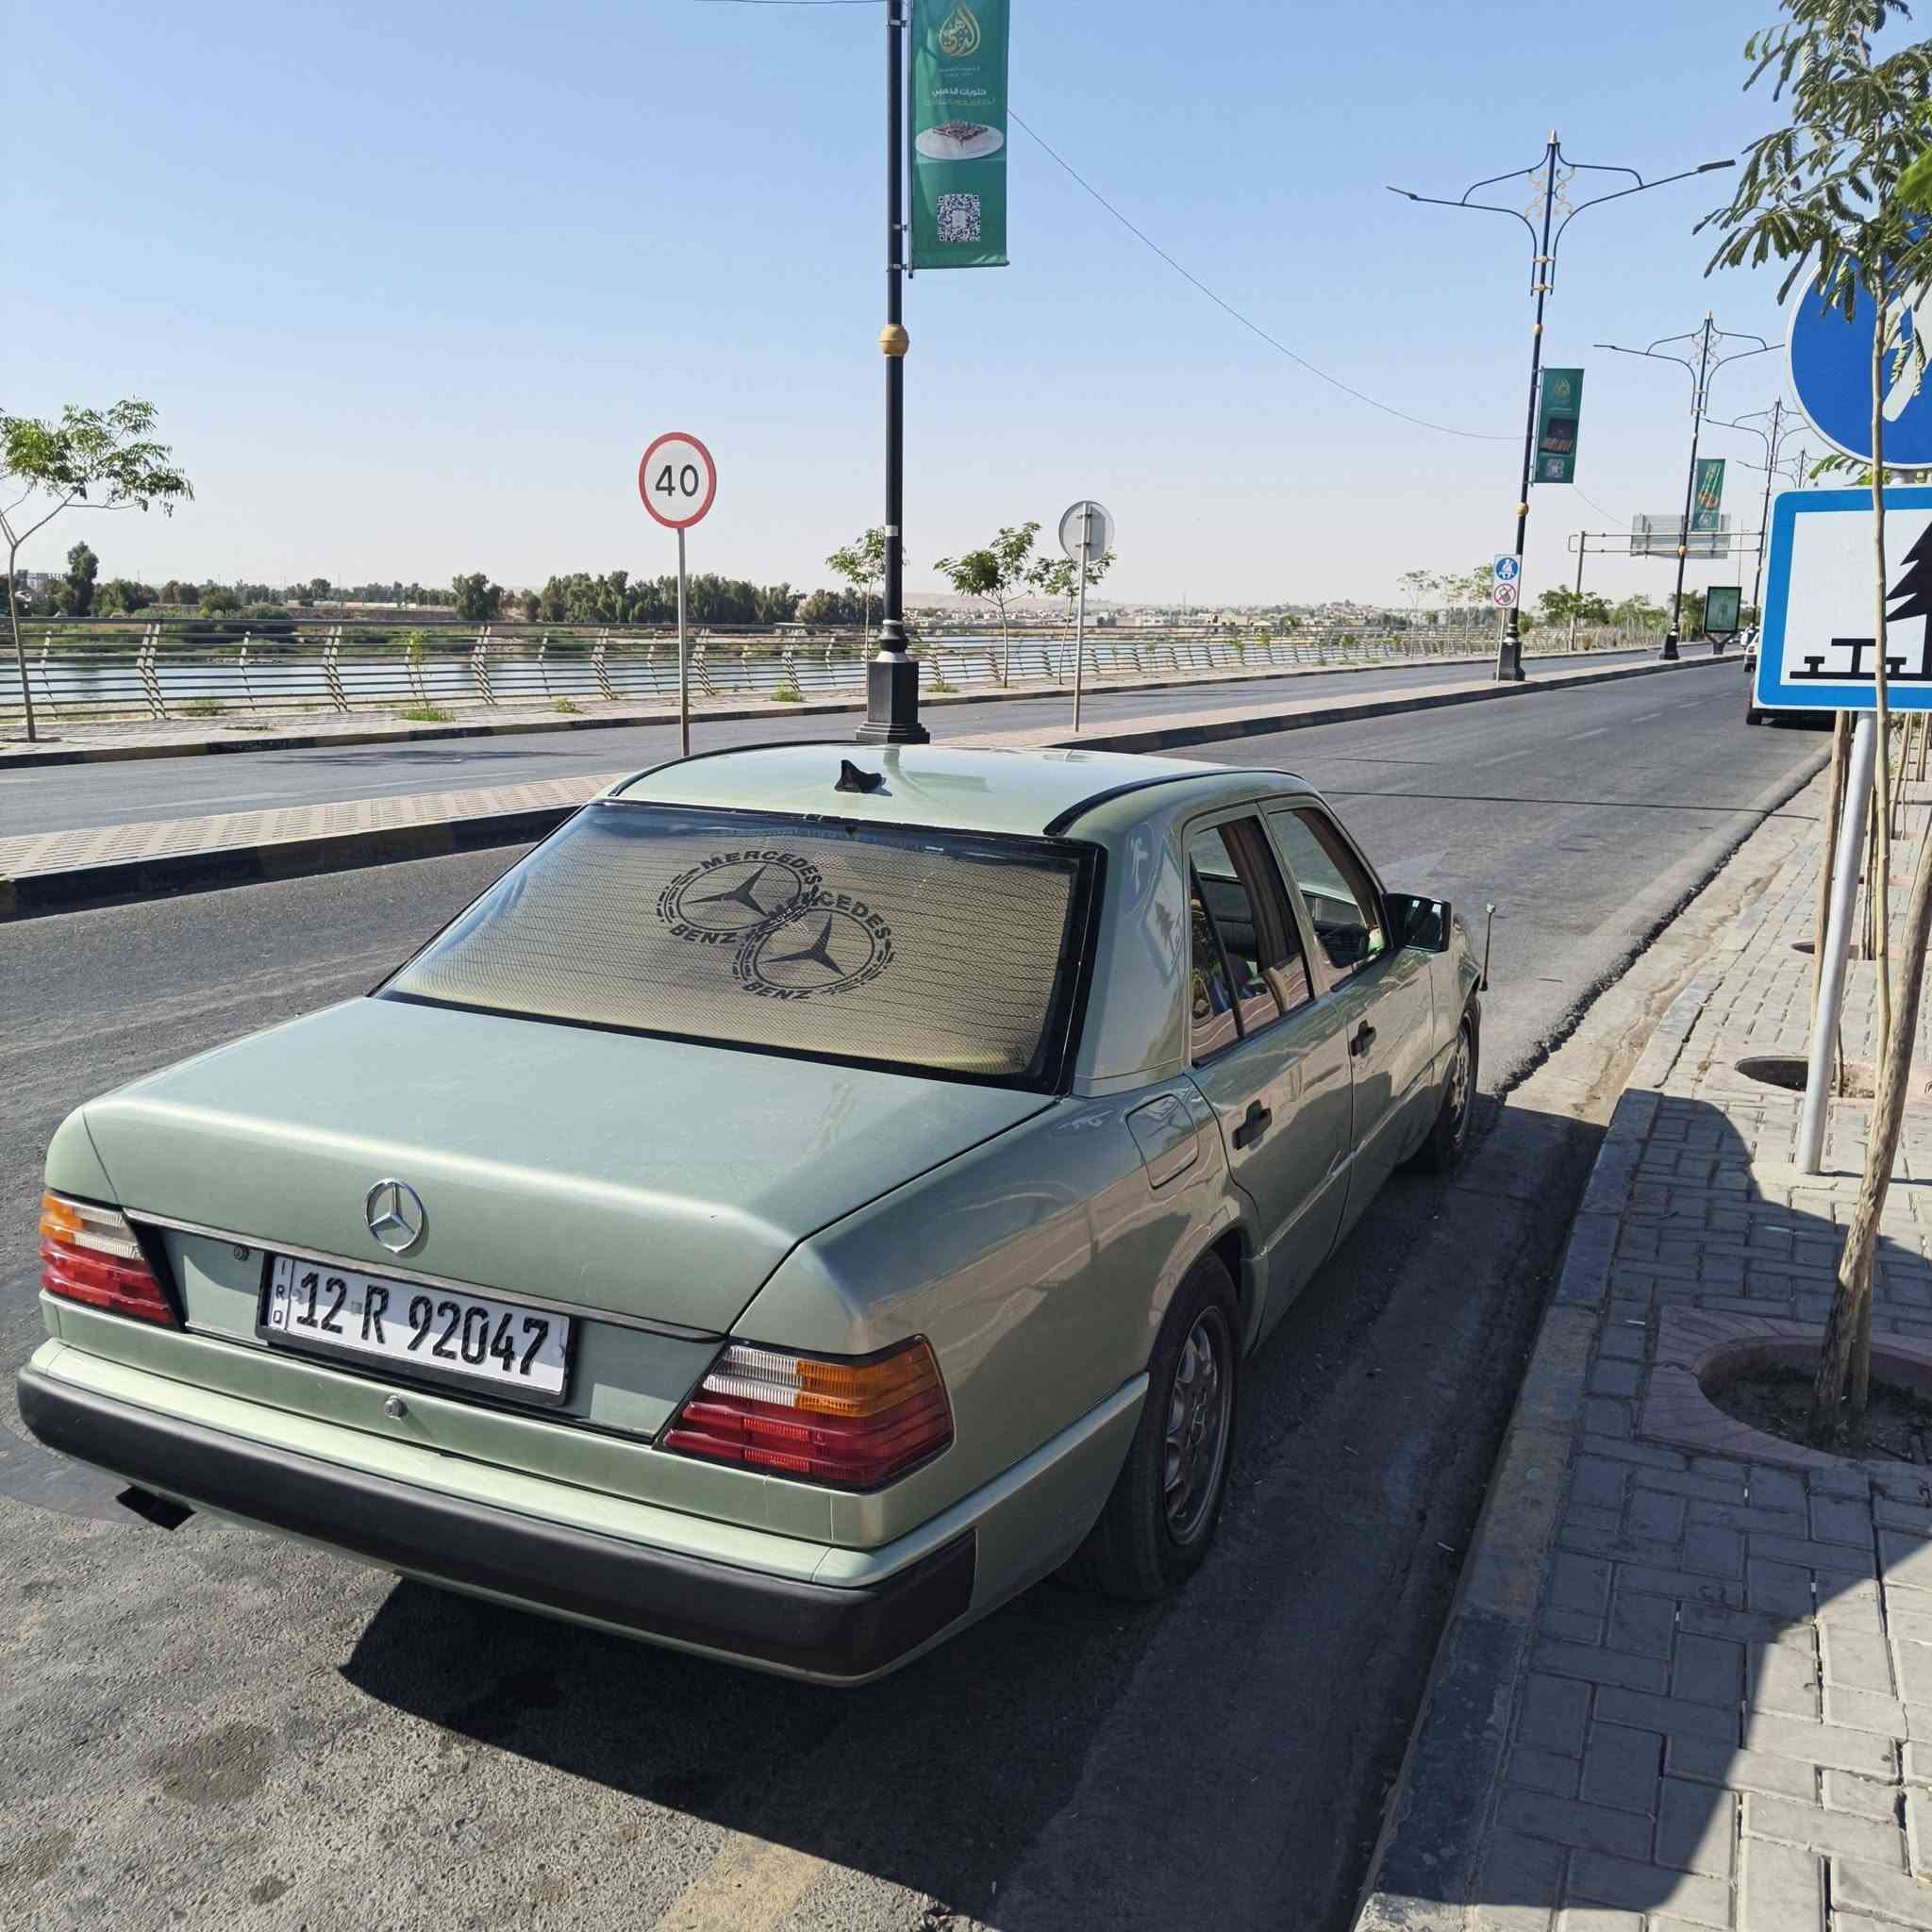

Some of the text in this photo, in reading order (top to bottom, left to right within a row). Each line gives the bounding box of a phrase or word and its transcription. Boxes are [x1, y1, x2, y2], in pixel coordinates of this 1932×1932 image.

[655, 464, 699, 497] 40
[700, 850, 824, 885] MERCEDES
[670, 924, 738, 944] BENZ
[741, 981, 813, 1000] BENZ
[296, 1272, 549, 1375] 12 R 92047
